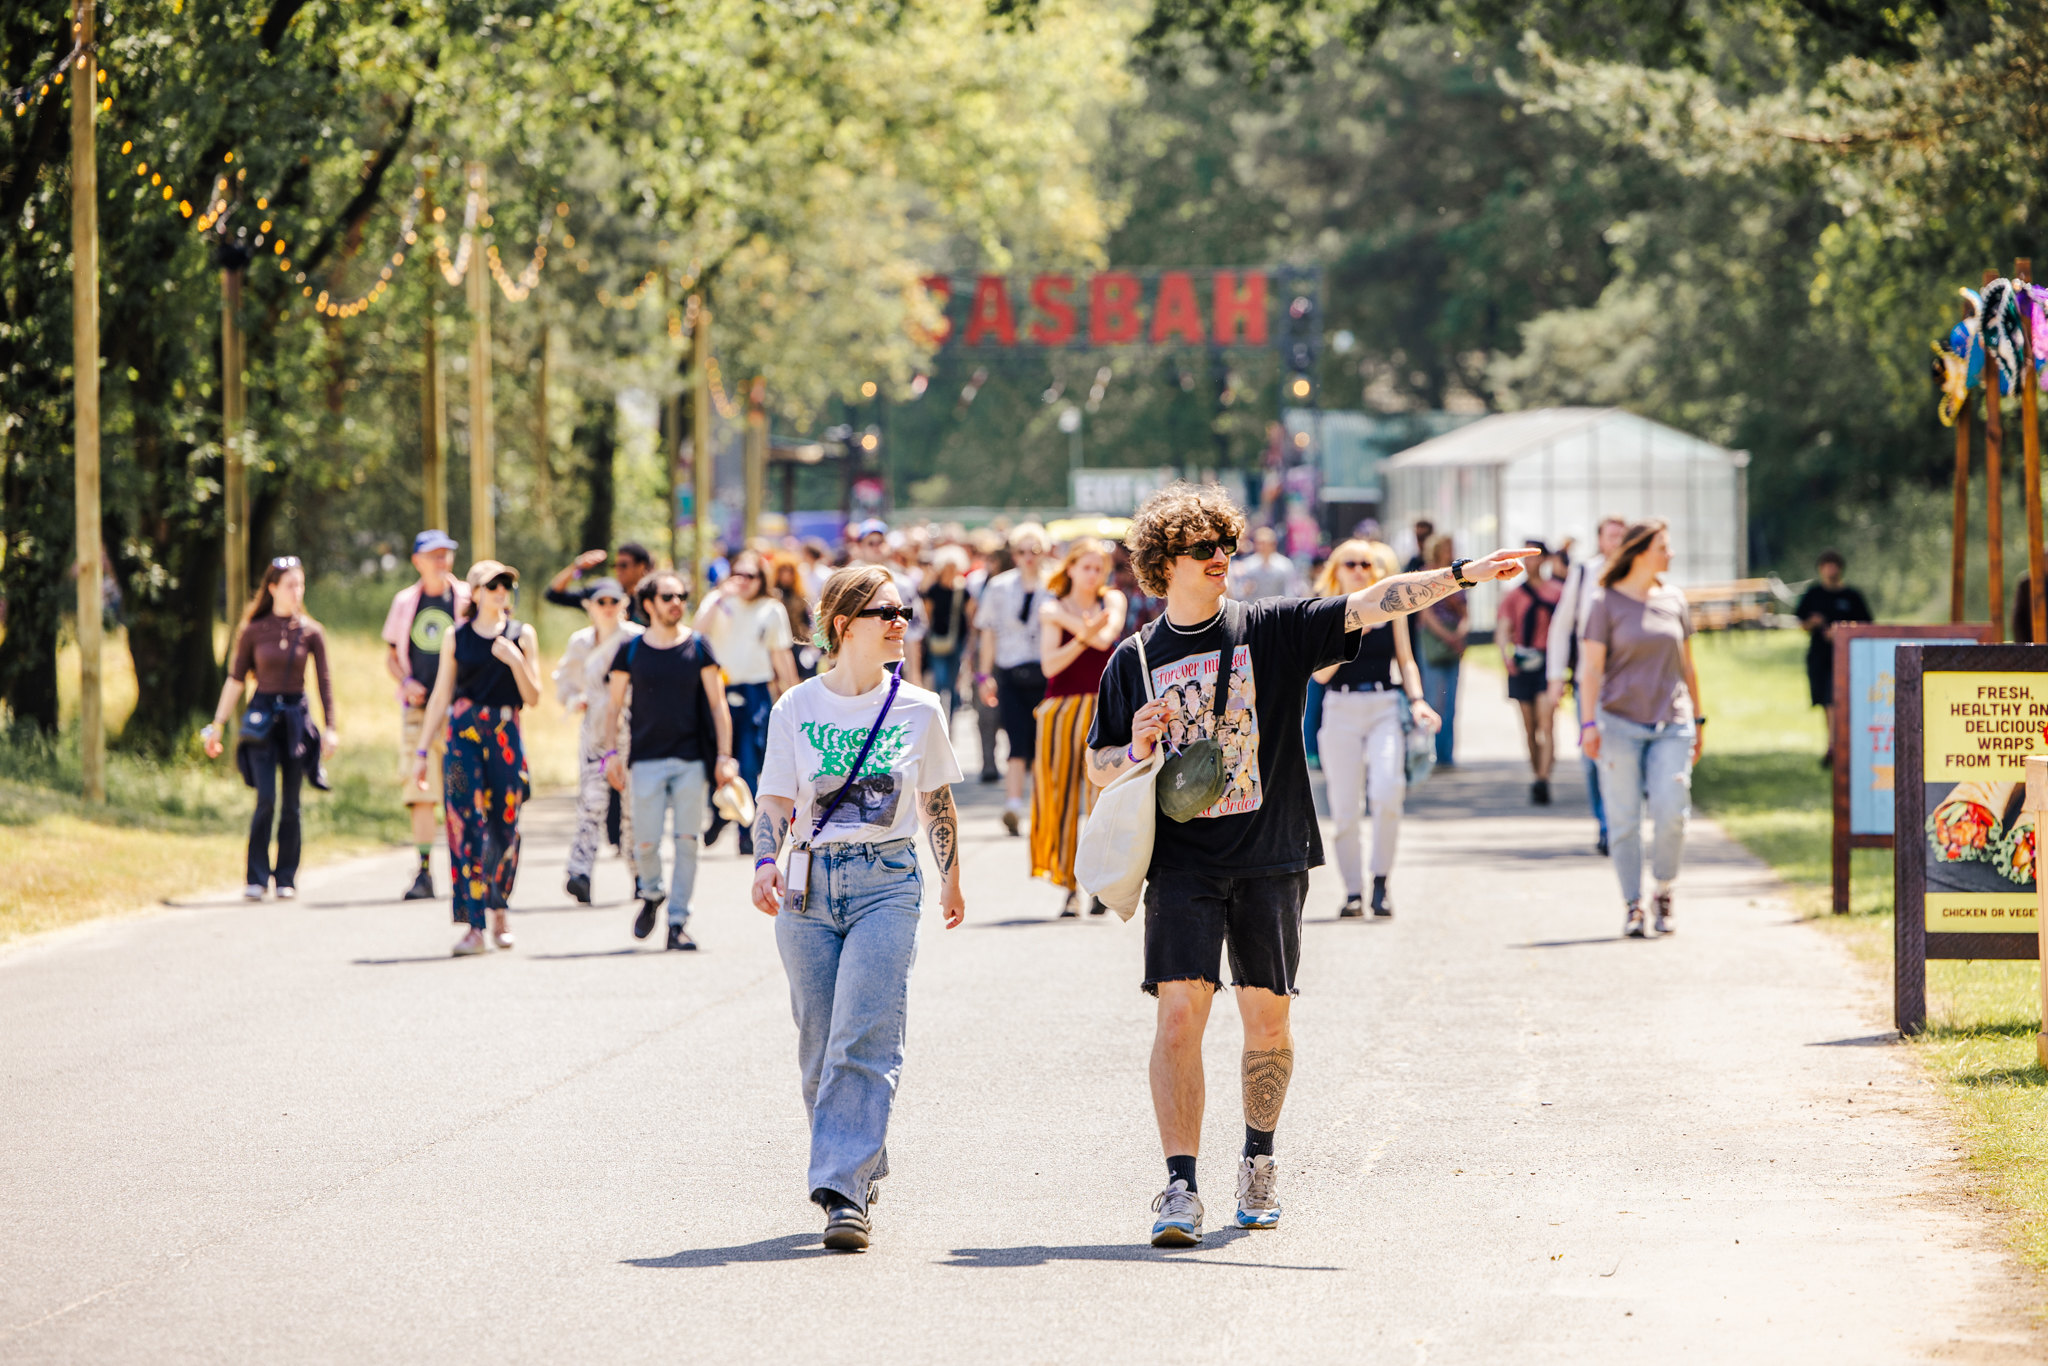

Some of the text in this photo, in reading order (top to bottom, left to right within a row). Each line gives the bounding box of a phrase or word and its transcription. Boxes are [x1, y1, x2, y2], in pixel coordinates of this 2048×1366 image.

[1156, 648, 1247, 688] Forever mied
[1977, 686, 2034, 700] FRESH,
[1950, 703, 2022, 716] HEALTHY
[1965, 720, 2046, 733] DELICIOUS
[1977, 737, 2034, 750] WRAPS
[1945, 754, 2027, 767] FROM THE
[1219, 793, 1259, 815] Order
[1942, 907, 1987, 918] CHICKEN
[1991, 907, 2005, 918] OR
